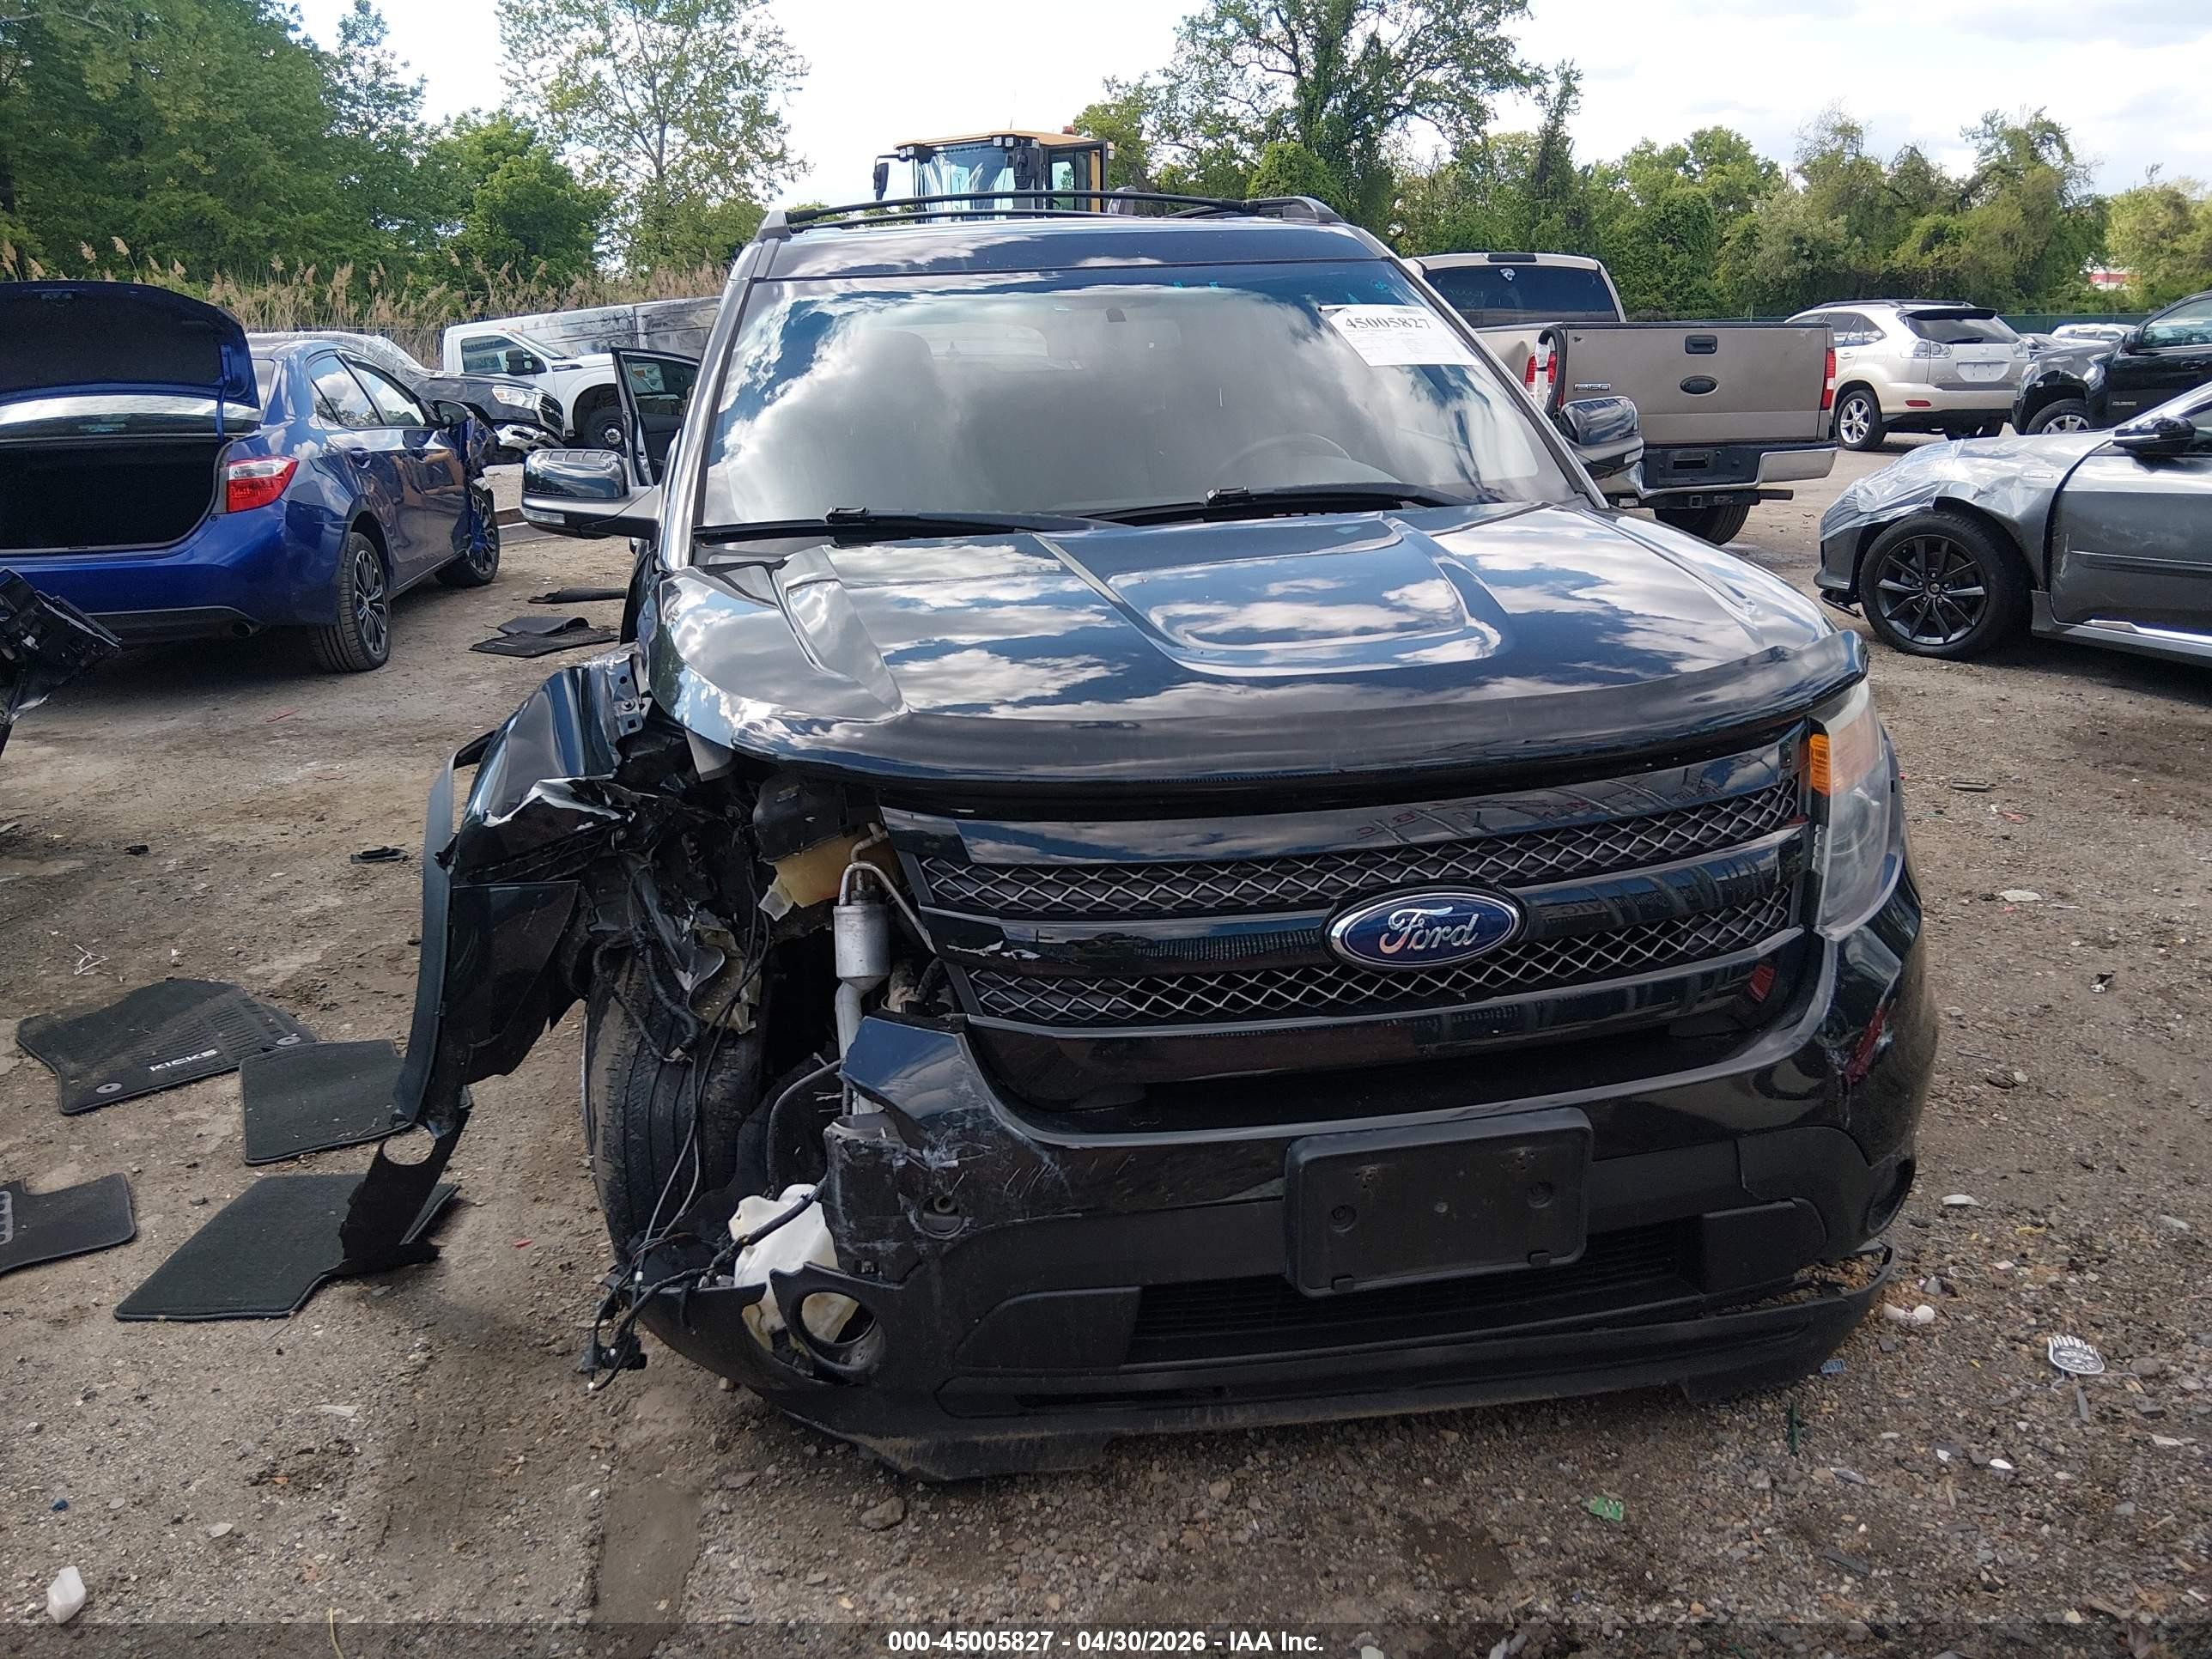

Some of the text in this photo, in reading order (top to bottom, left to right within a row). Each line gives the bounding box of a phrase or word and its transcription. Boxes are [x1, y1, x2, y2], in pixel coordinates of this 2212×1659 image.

[1345, 317, 1431, 330] 45005827
[1379, 906, 1479, 954] Ford
[149, 1049, 218, 1072] KICKS
